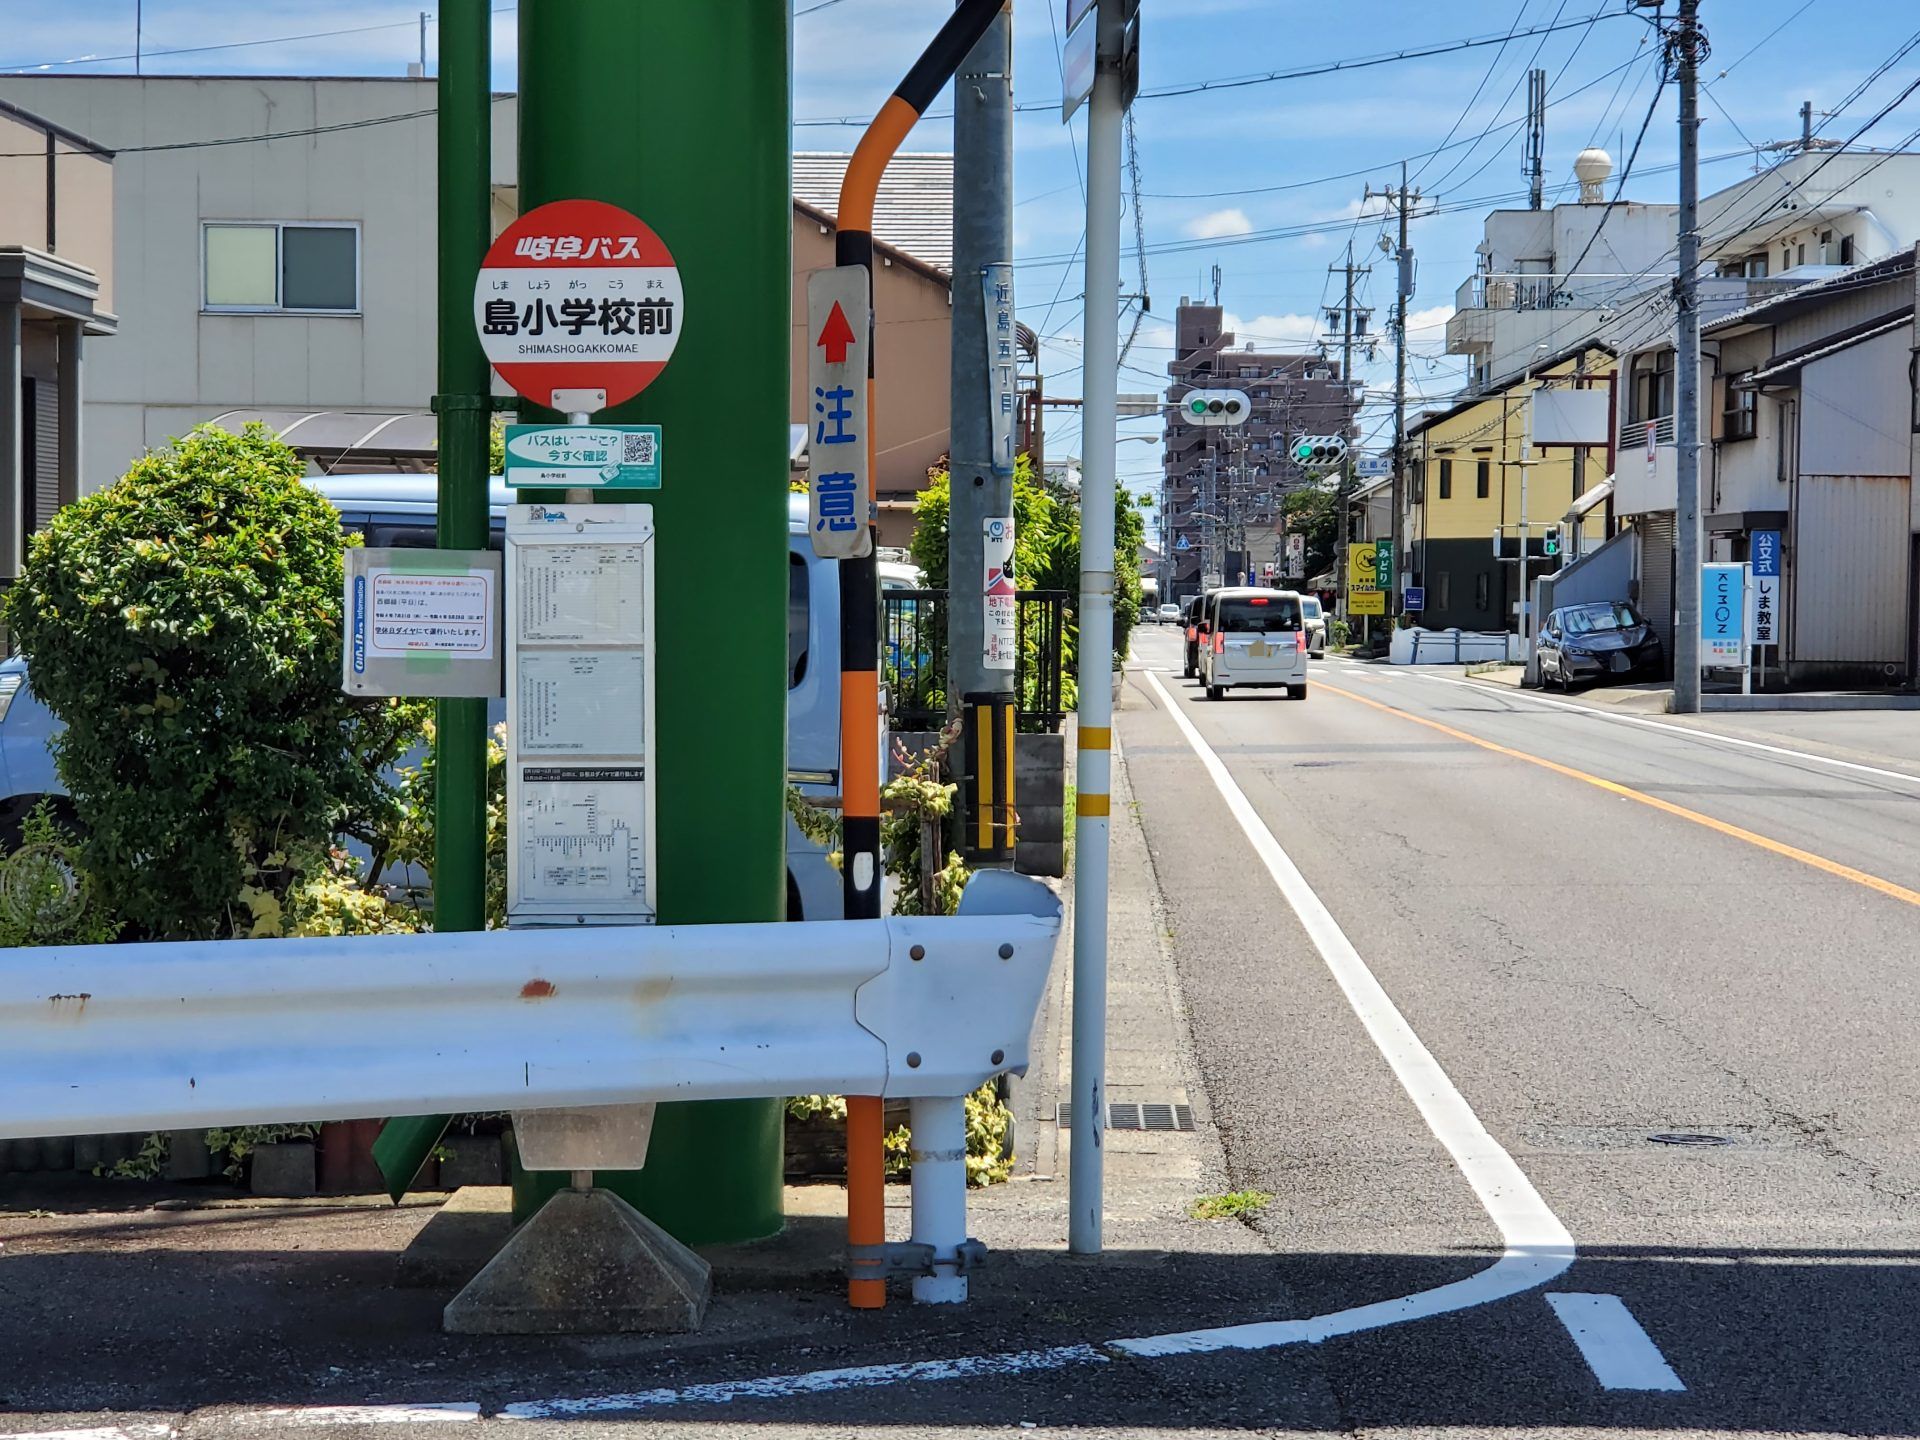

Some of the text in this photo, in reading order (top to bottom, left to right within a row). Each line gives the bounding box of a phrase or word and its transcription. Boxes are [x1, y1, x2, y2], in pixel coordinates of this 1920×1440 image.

[515, 236, 641, 261] 岐阜バス
[492, 279, 664, 290] しま しょう がっ こう まえ
[483, 297, 675, 336] 島小学校前
[518, 343, 639, 354] SHIMASHOGAKKOMAE
[995, 281, 1012, 459] 近島五丁目 1
[548, 449, 608, 461] 今すぐ確認
[815, 385, 858, 532] 注意
[1378, 548, 1390, 583] みどり
[1758, 533, 1773, 573] 公文式
[356, 580, 364, 619] Information
[1351, 584, 1376, 592] スマイルカ
[1714, 572, 1730, 634] KUMON
[1756, 579, 1772, 641] しま教室
